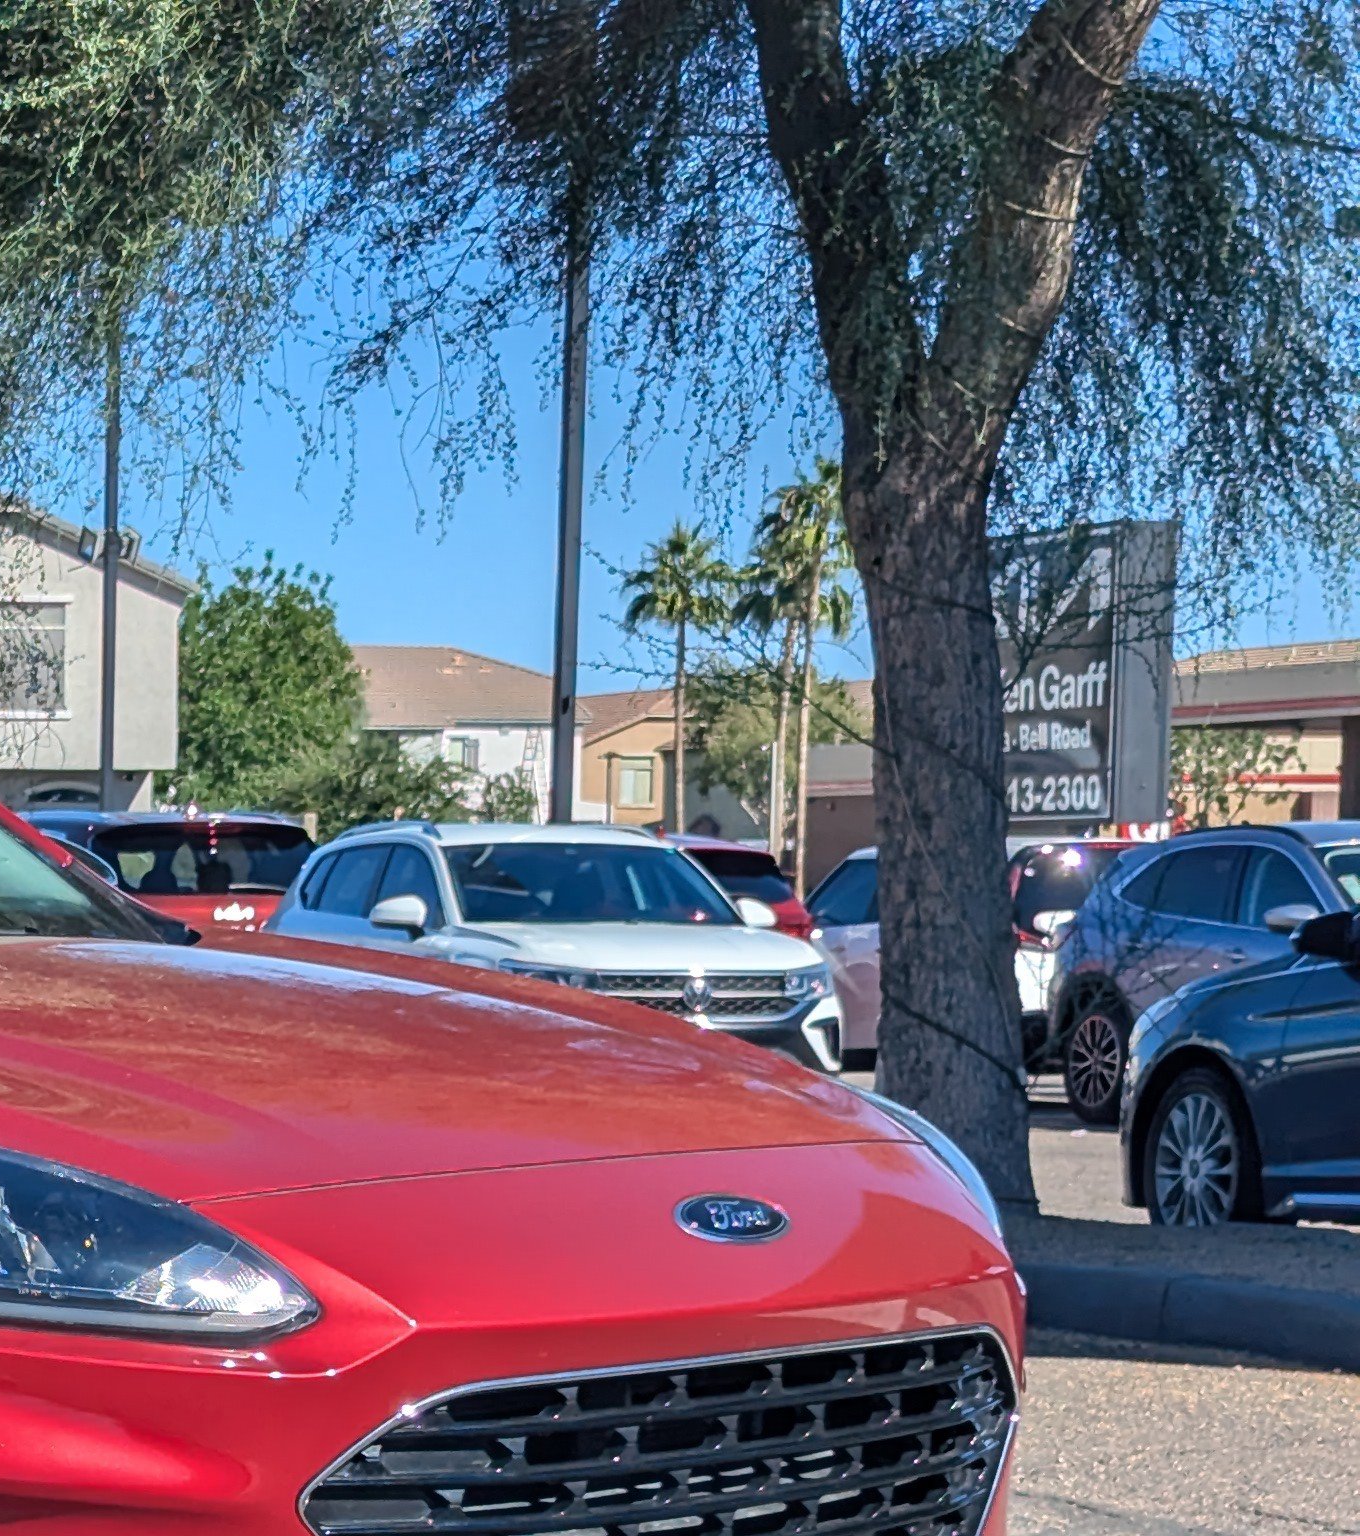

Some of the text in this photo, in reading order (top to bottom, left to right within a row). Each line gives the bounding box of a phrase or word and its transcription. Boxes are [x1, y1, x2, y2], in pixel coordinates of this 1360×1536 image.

[1000, 660, 1108, 713] en Garff
[1019, 722, 1048, 751] Bell
[1051, 719, 1092, 750] Road
[1007, 774, 1102, 813] 13-2300
[704, 1200, 769, 1230] Ford
